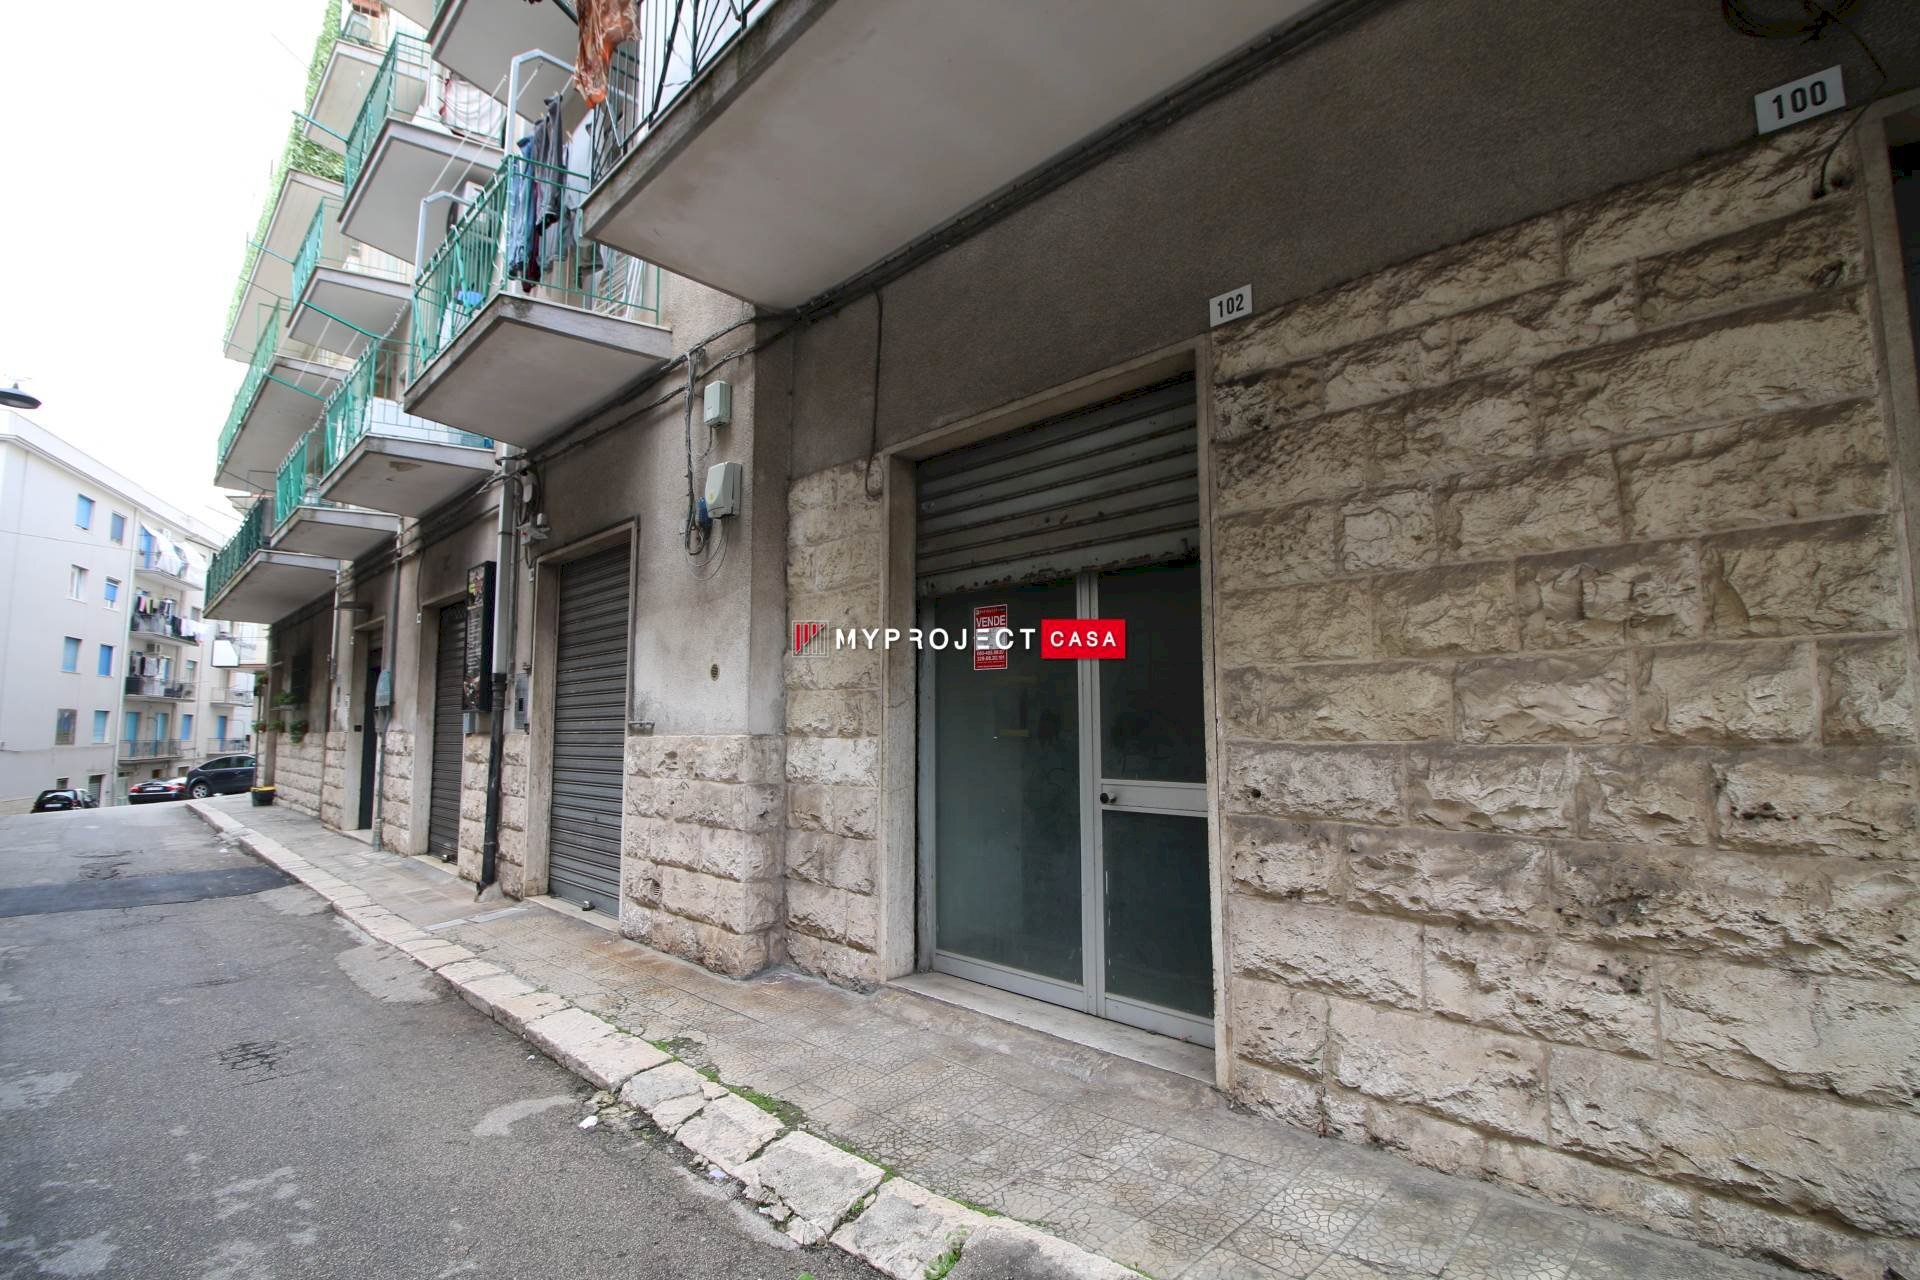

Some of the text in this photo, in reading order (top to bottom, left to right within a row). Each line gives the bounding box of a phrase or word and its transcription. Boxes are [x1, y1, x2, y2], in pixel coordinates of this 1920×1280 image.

[1772, 81, 1827, 120] 100
[1217, 293, 1244, 318] 102
[976, 615, 1006, 627] VENDE
